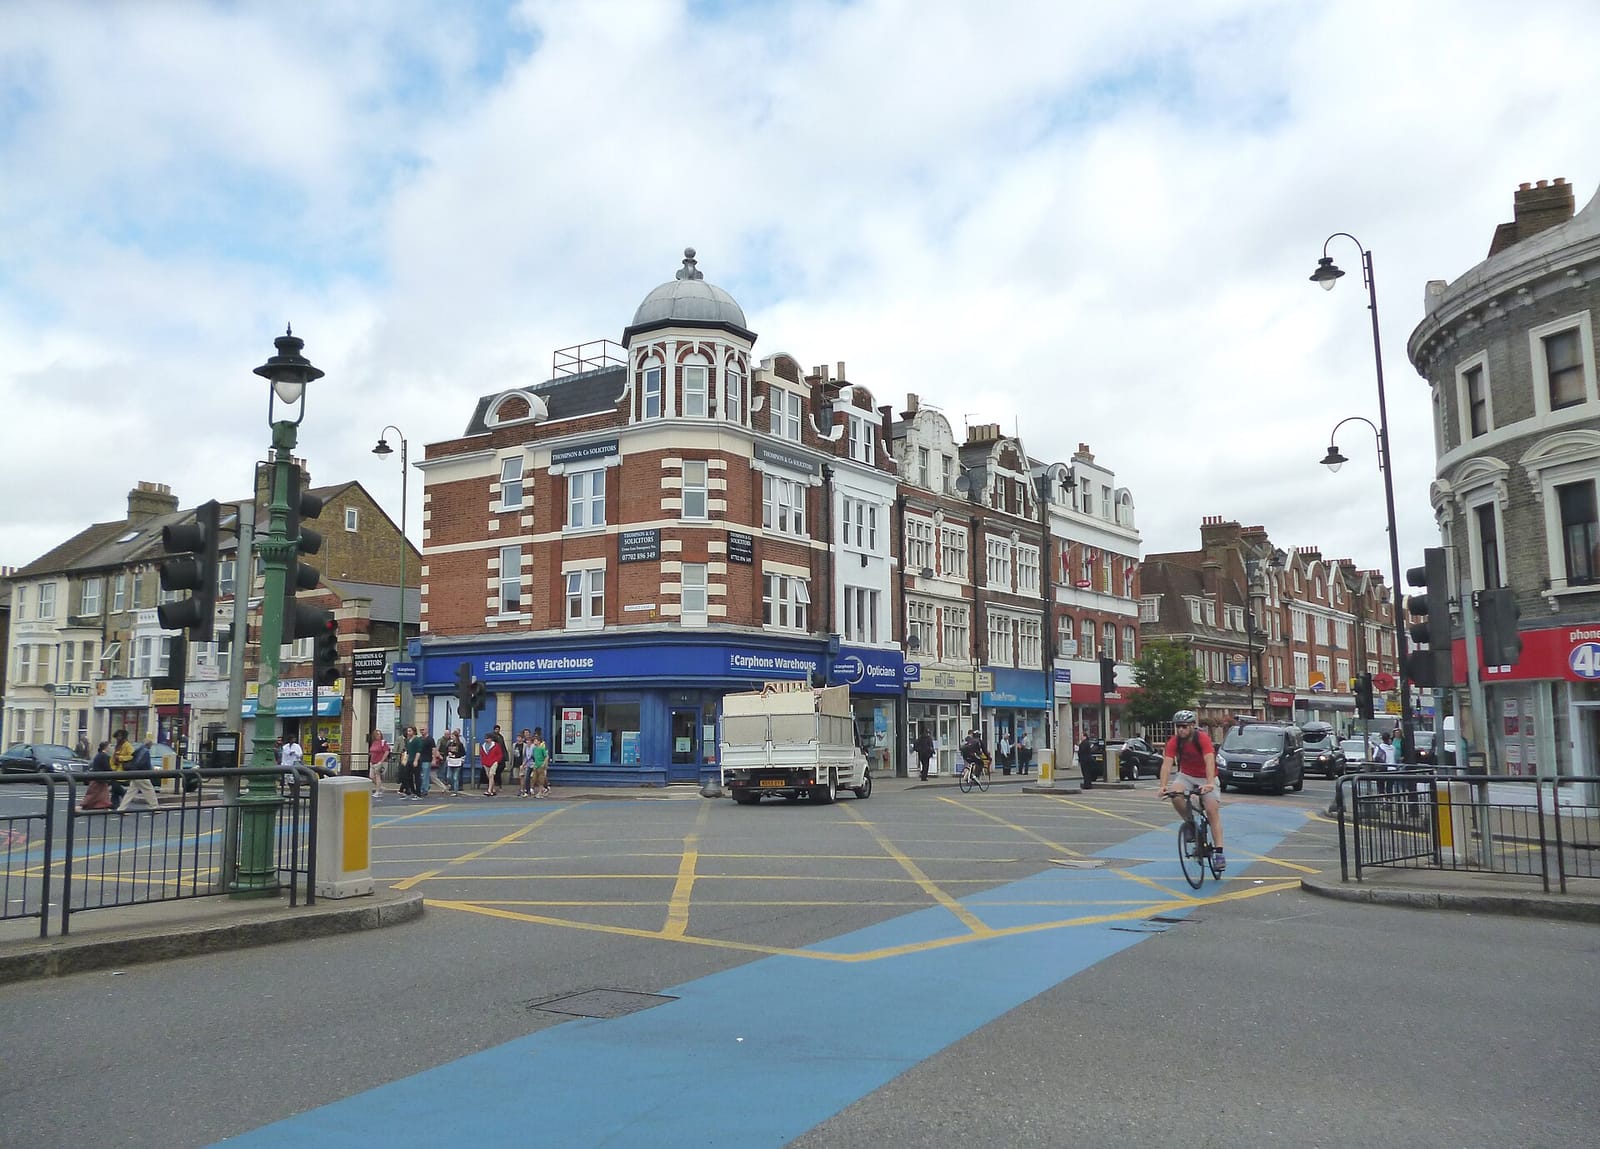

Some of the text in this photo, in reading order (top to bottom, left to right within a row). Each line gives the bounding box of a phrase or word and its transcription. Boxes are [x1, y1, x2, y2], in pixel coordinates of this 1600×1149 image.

[552, 451, 578, 461] THOMPSON
[590, 445, 617, 454] SOLICITORS
[624, 536, 654, 545] SOLICITORS
[354, 659, 383, 667] SOLICITORS
[489, 660, 536, 672] Carphone
[537, 657, 594, 669] Warehouse
[735, 655, 774, 668] Carphone
[775, 658, 817, 670] Warehouse
[866, 664, 896, 677] Opticians
[71, 686, 90, 694] VET
